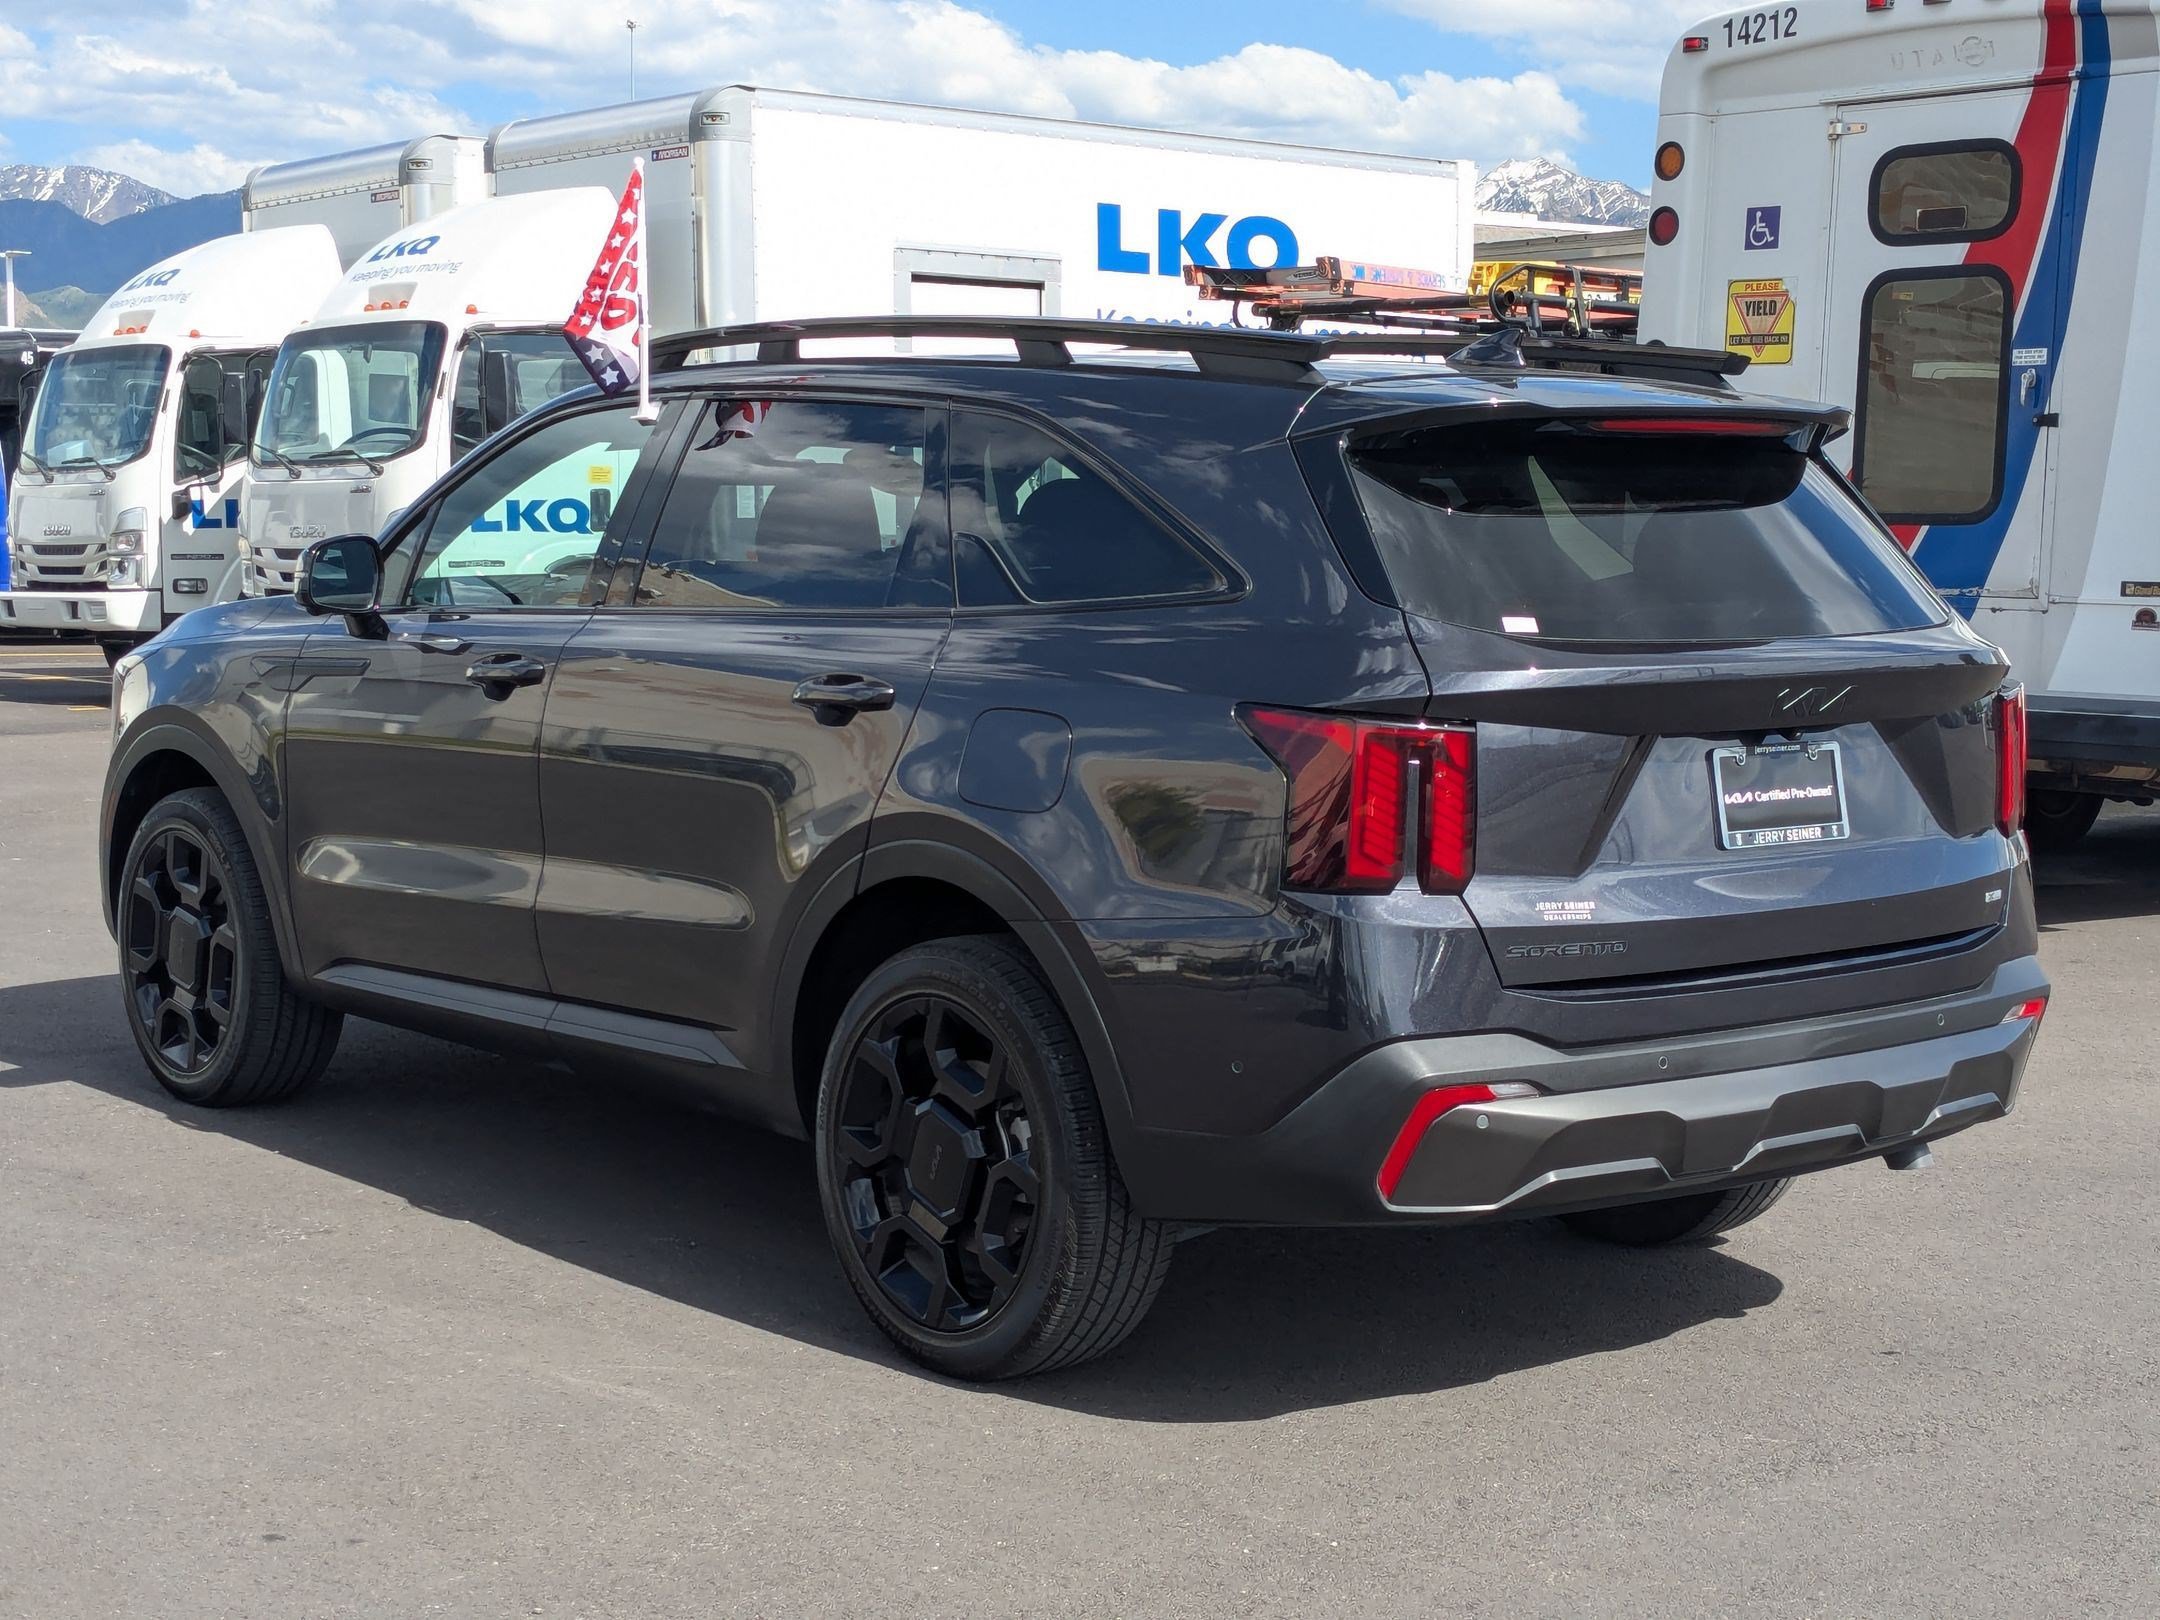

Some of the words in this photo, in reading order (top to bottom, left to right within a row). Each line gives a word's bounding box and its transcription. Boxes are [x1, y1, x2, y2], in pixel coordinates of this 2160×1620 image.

[1722, 6, 1798, 48] 14212
[366, 235, 441, 263] LKQ
[123, 268, 181, 292] LKQ
[1744, 282, 1780, 292] PLEASE
[1745, 299, 1778, 317] YIELD
[21, 350, 34, 365] 45
[1754, 744, 1801, 755] jerryseiner.com
[1754, 788, 1791, 802] Certified
[1753, 829, 1785, 844] JERRY
[1786, 826, 1822, 841] SEINER
[1535, 901, 1563, 911] JERRY
[1564, 901, 1596, 910] SEINER
[1543, 913, 1592, 921] DEALERSHIPS
[1505, 941, 1629, 959] SORENTO
